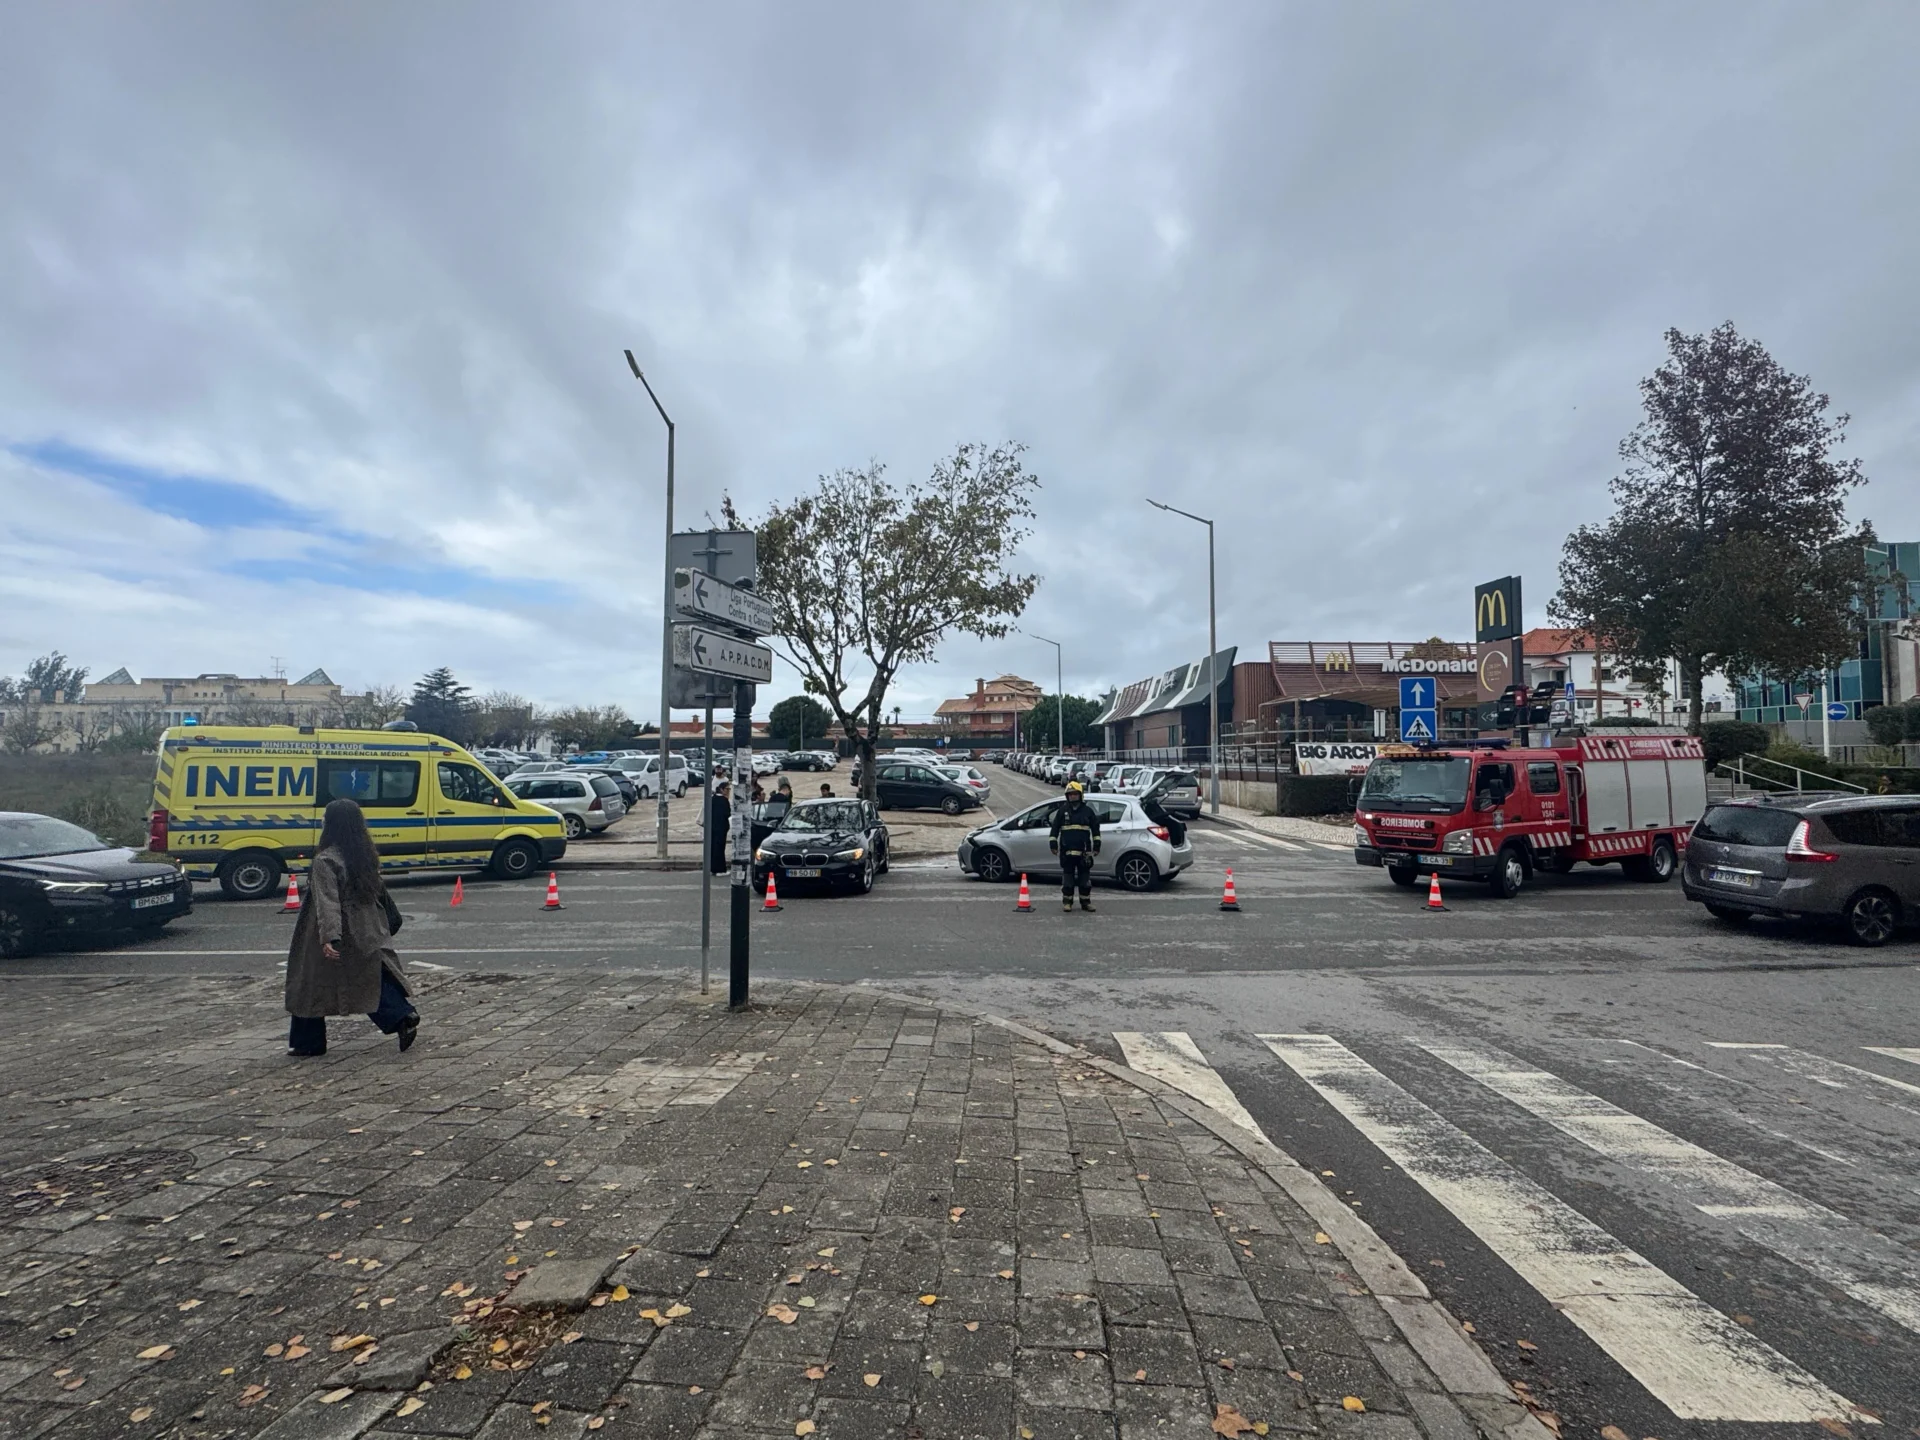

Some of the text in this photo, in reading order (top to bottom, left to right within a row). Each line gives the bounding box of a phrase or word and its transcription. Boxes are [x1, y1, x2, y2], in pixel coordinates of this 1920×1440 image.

[728, 604, 747, 621] Contra
[743, 595, 772, 616] Portuguesa
[1298, 745, 1377, 760] BIG ARCH
[186, 766, 315, 797] INEM
[187, 833, 220, 845] 112
